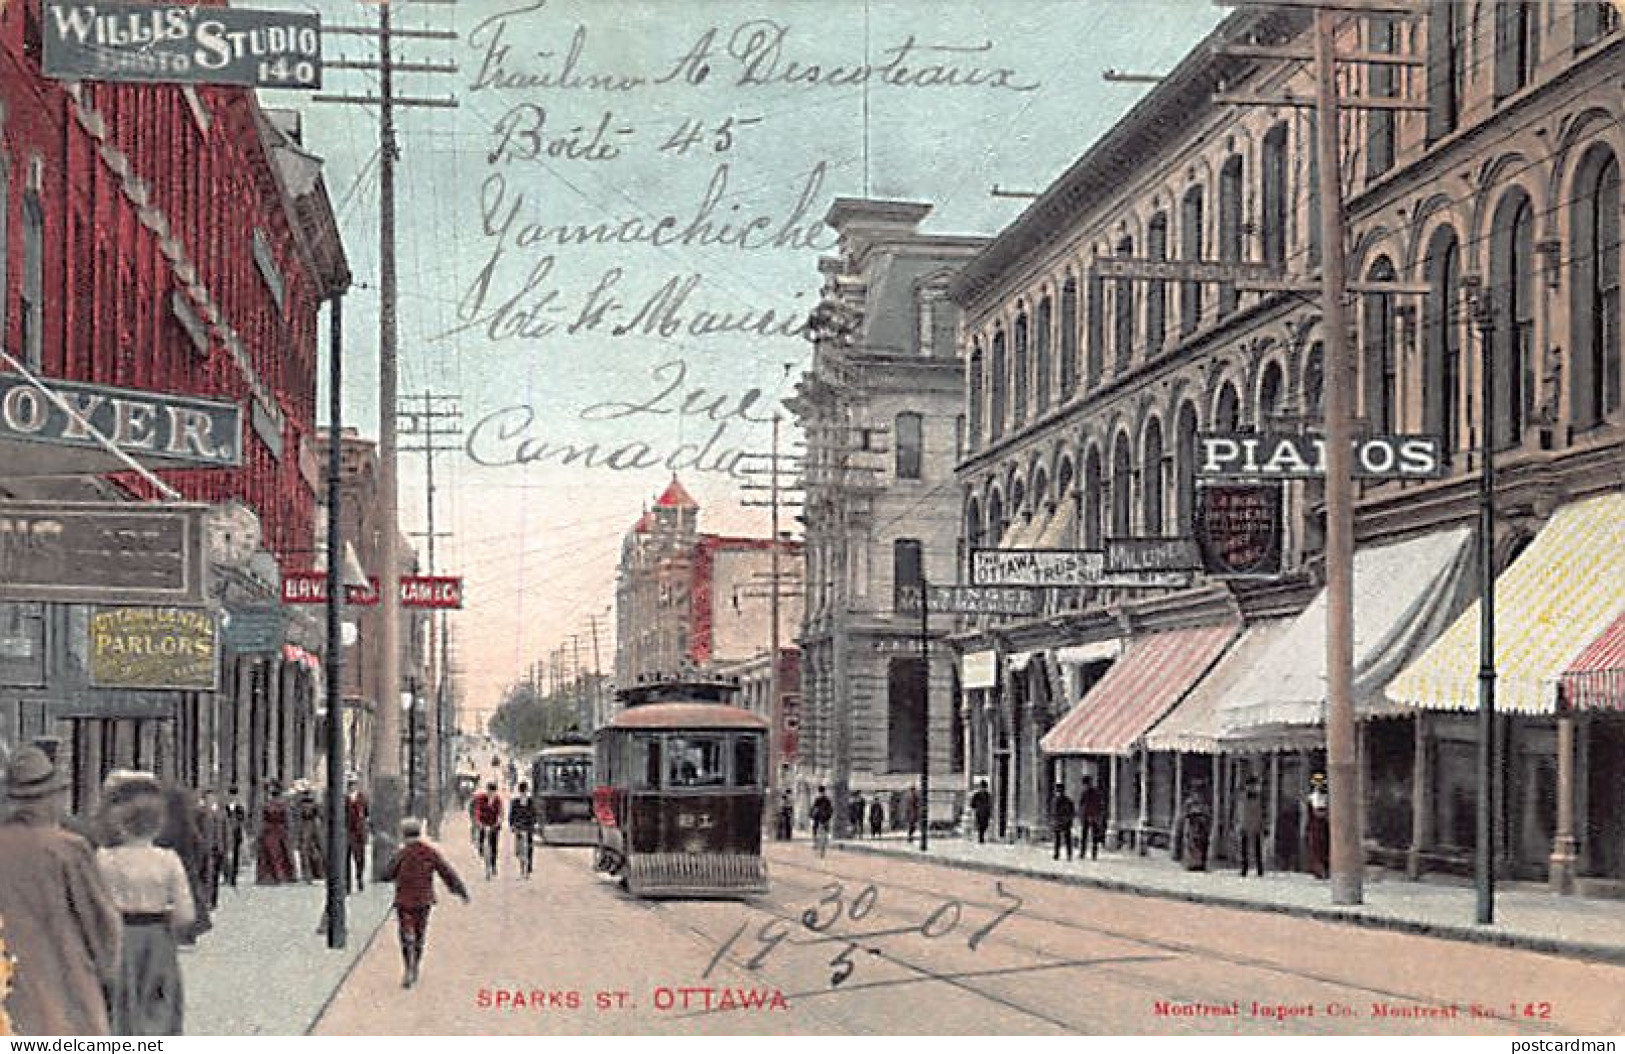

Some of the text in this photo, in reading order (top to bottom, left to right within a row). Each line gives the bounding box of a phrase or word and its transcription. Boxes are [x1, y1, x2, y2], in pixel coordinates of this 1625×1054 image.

[194, 21, 318, 69] STUDIO
[257, 58, 316, 83] 140
[658, 116, 763, 154] 45
[467, 404, 754, 479] Canada
[96, 634, 213, 657] PARLORS
